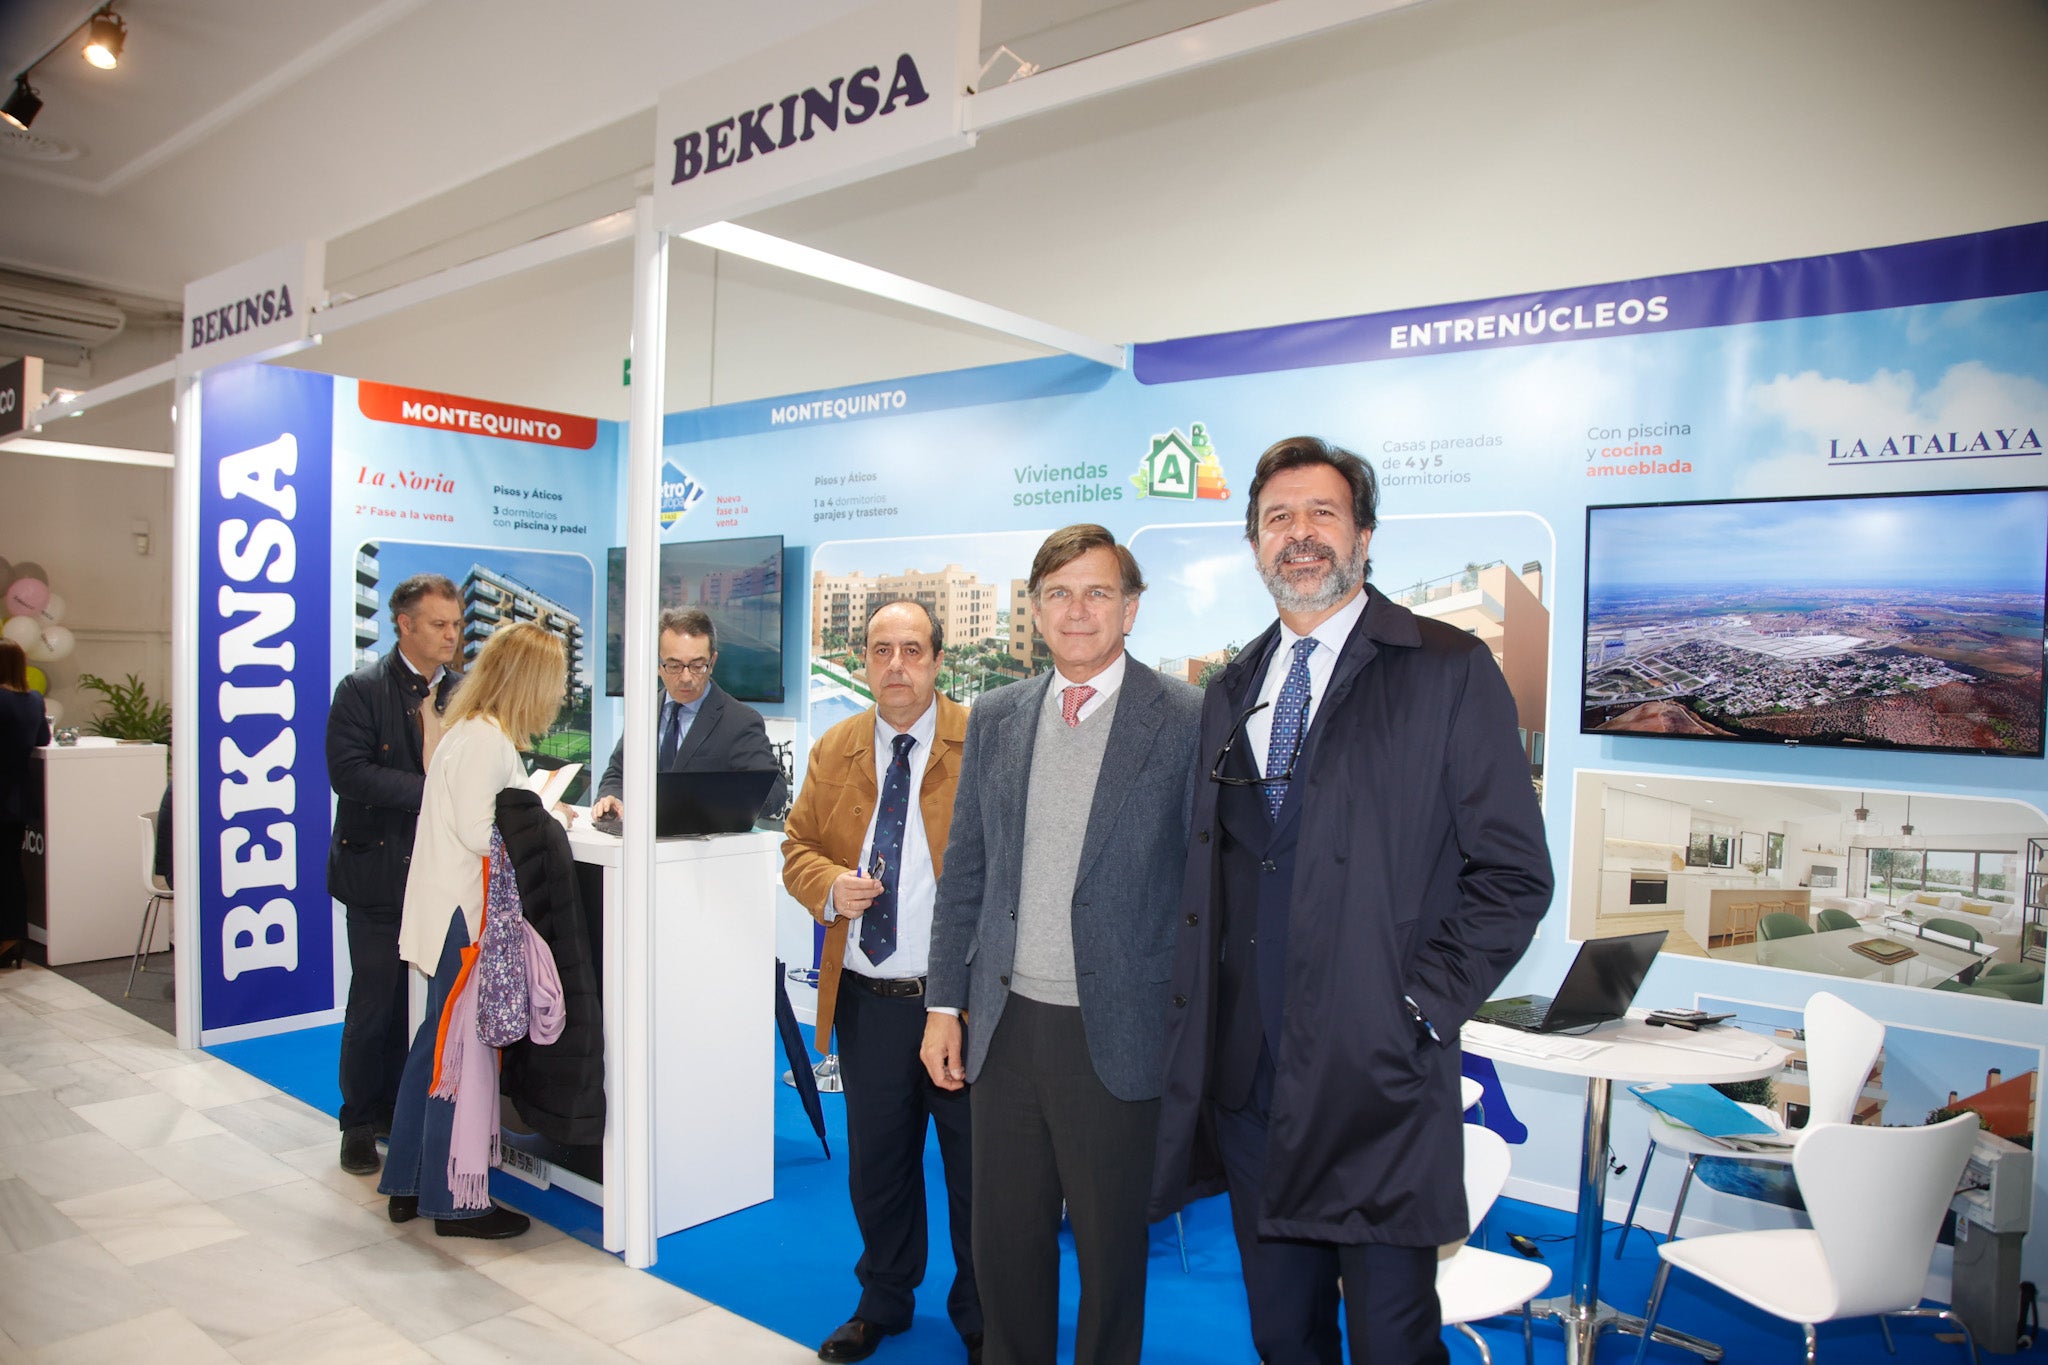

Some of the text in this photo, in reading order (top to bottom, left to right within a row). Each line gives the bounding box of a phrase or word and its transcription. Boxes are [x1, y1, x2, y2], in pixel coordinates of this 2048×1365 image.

[671, 53, 929, 185] BEKINSA
[191, 284, 293, 349] BEKINSA
[1390, 296, 1669, 349] ENTRENÚCLEOS
[771, 390, 907, 425] MONTEQUINTO
[402, 400, 562, 440] MONTEQUINTO
[1587, 422, 1691, 441] Con piscina
[1382, 434, 1503, 453] Casas pareadas
[1586, 441, 1663, 462] y cocina
[1829, 428, 2043, 459] LA ATALAYA
[1158, 454, 1184, 484] A
[1382, 455, 1443, 471] de 4 y 5
[1586, 459, 1693, 477] amueblada
[814, 470, 878, 486] Pisos y Áticos
[1014, 462, 1108, 484] Viviendas
[1381, 470, 1472, 487] dormitorios
[494, 485, 563, 501] Pisos y Áticos
[716, 495, 741, 504] Nueva
[835, 493, 887, 507] dormitorios
[1013, 484, 1123, 507] sostenibles
[370, 506, 397, 517] Fase
[400, 510, 406, 518] a
[410, 509, 420, 519] la
[423, 512, 455, 522] venta
[493, 506, 558, 520] 3 dormitorios
[716, 506, 733, 516] fase
[813, 507, 899, 522] garajes y trasteros
[493, 519, 587, 534] con piscina y padel
[716, 519, 738, 527] venta
[218, 432, 298, 981] BEKINSA
